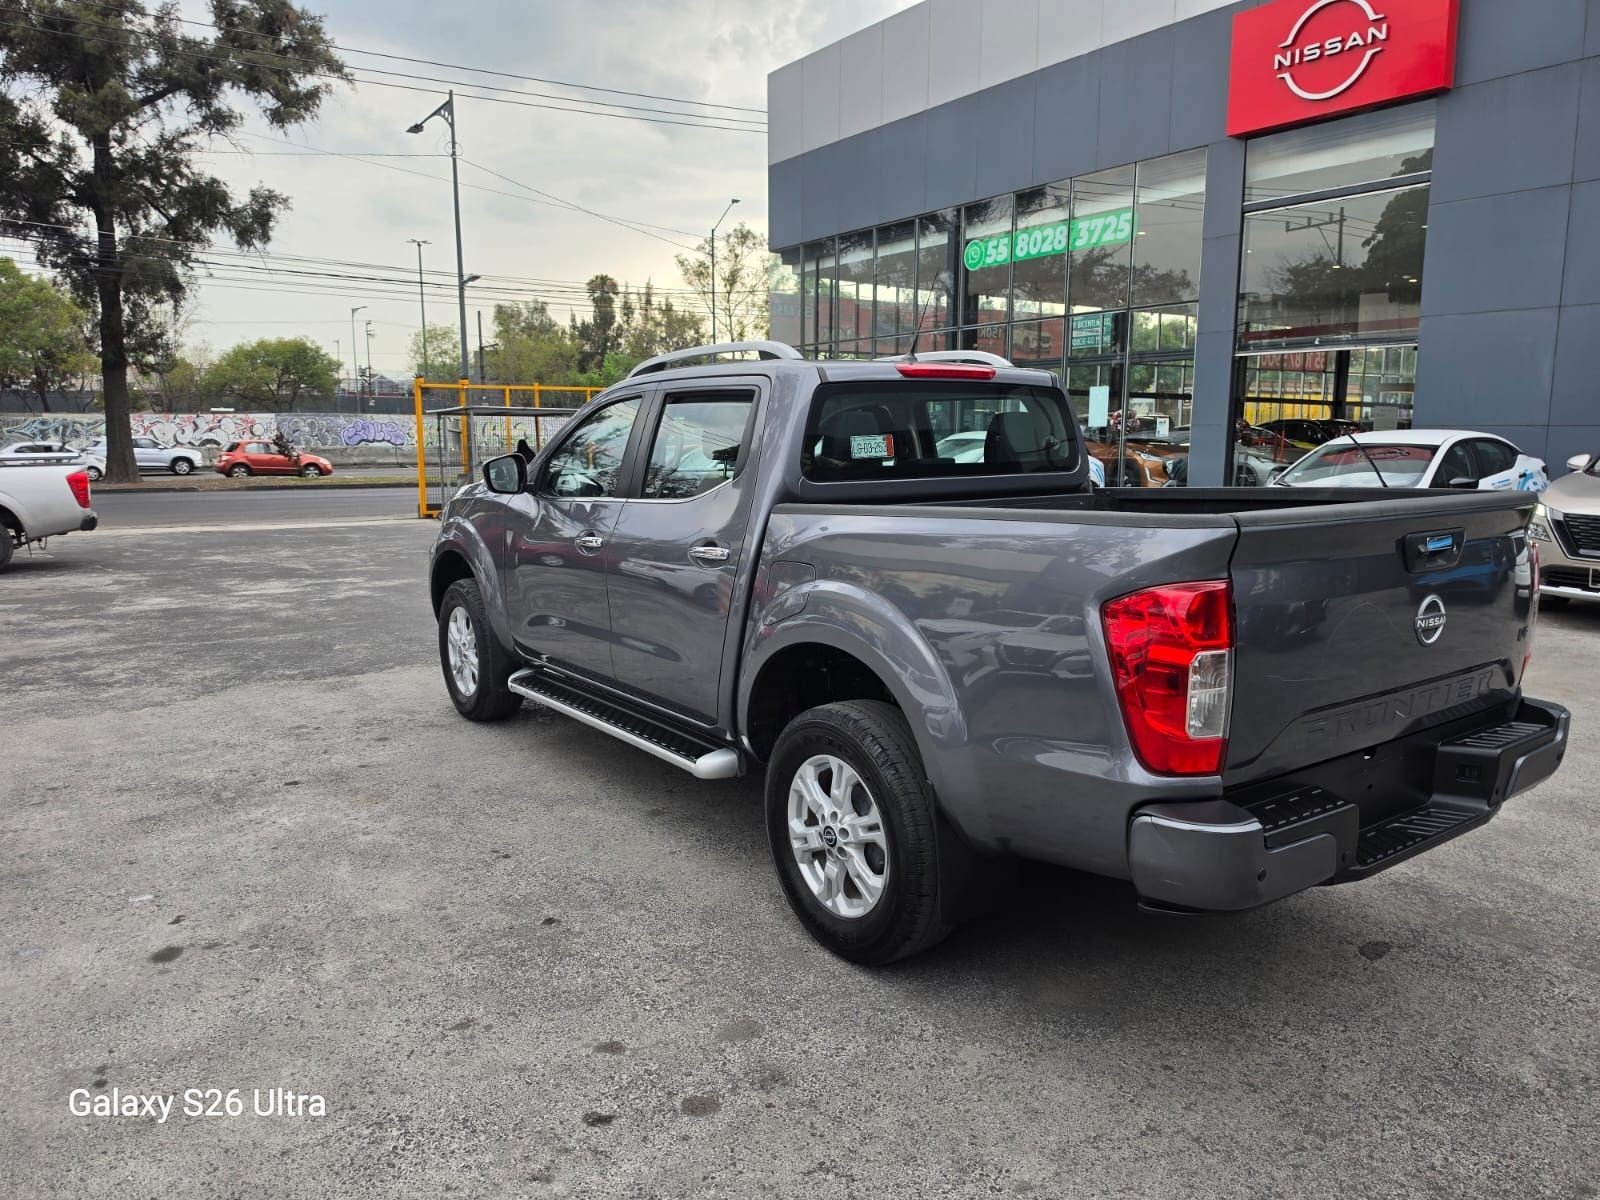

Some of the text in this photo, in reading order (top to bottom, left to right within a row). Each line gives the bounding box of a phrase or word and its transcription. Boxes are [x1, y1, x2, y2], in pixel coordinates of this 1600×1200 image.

[1274, 23, 1388, 70] NISSAN
[985, 212, 1132, 264] 55 8028 3725
[1416, 615, 1446, 628] NISSAN
[1302, 670, 1494, 743] FRONTIER
